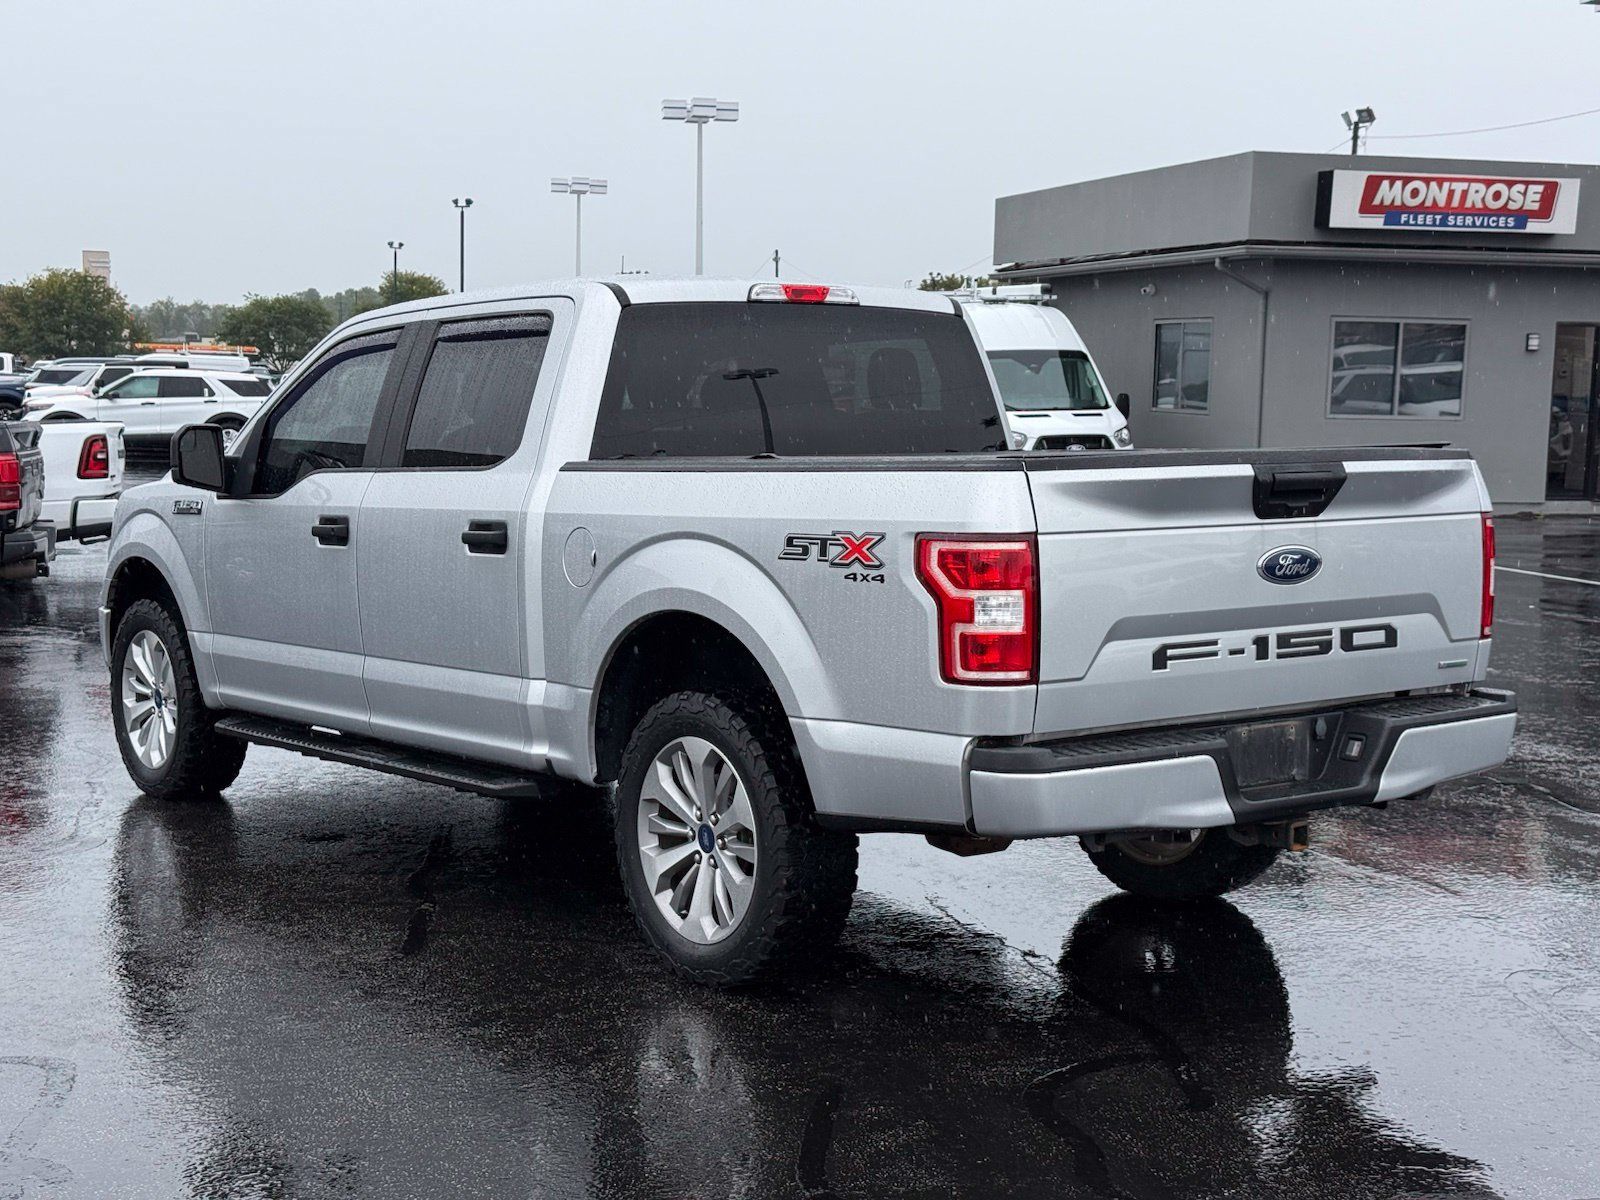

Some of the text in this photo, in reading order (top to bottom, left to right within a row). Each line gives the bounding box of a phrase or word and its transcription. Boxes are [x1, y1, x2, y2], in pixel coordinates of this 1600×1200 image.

[1372, 179, 1545, 211] MONTROSE
[1400, 213, 1515, 228] FLEET SERVICES
[778, 530, 887, 570] STX
[1275, 553, 1311, 576] Ford
[1152, 623, 1398, 672] F-150
